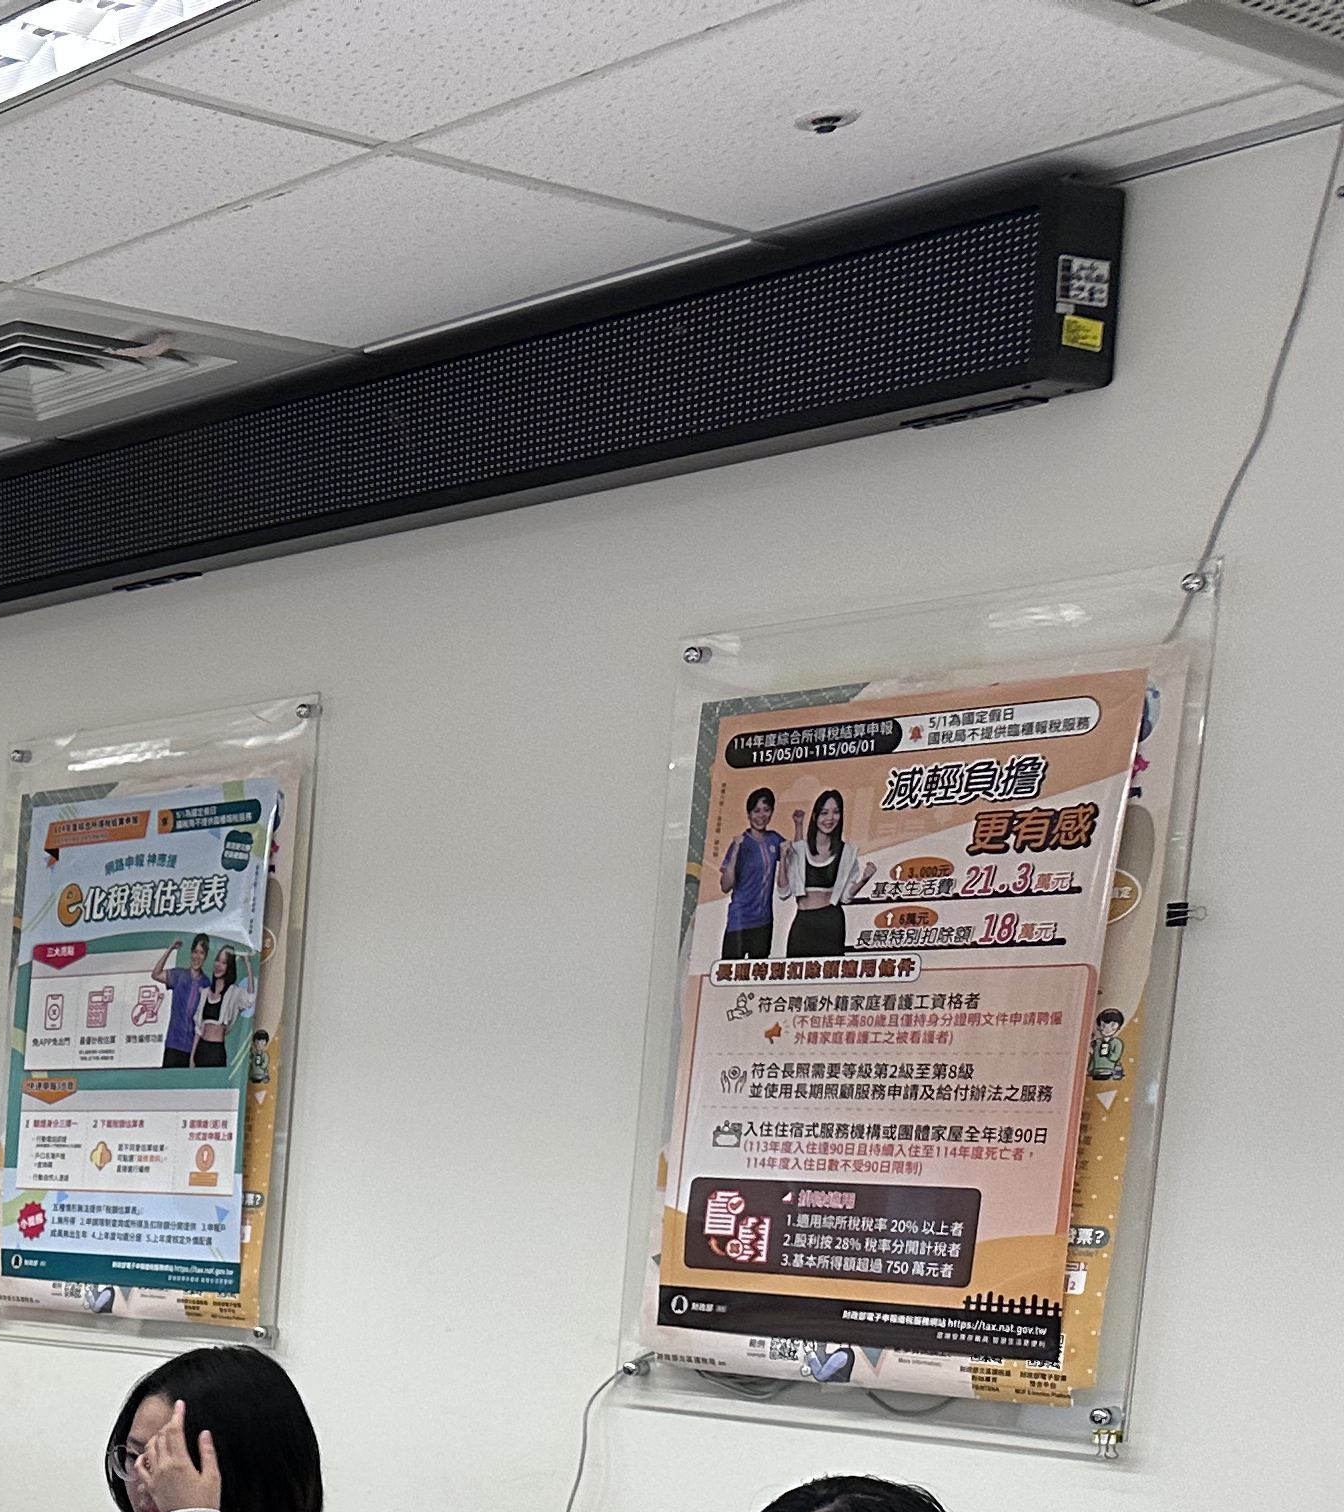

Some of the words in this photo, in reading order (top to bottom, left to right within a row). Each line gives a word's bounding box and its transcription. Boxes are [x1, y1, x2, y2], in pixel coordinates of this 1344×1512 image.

[928, 707, 1015, 729] 5/1為國定假日
[752, 740, 876, 763] 115/05/01-115/06/01
[881, 753, 1047, 810] 減輕負擔
[965, 801, 1099, 856] 更有感
[871, 878, 956, 898] 基本生活費
[960, 862, 1035, 896] 21.3
[857, 926, 976, 947] 長照特別扣除額
[978, 912, 1019, 944] 18
[758, 992, 981, 1013] 符合聘僱外籍家庭看護工資格者
[751, 1062, 975, 1080] 符合長照需要等級第2級至第8級
[748, 1083, 1054, 1103] 並使用長期照顧服務申請及給付辦法之服務
[743, 1121, 1048, 1144] 入住住宿式服務機構或團體家屋全年達90日
[890, 1218, 919, 1234] 20%
[922, 1220, 964, 1237] 以上者
[835, 1236, 861, 1251] 28%
[886, 1260, 909, 1275] 750
[912, 1260, 954, 1279] 萬元者
